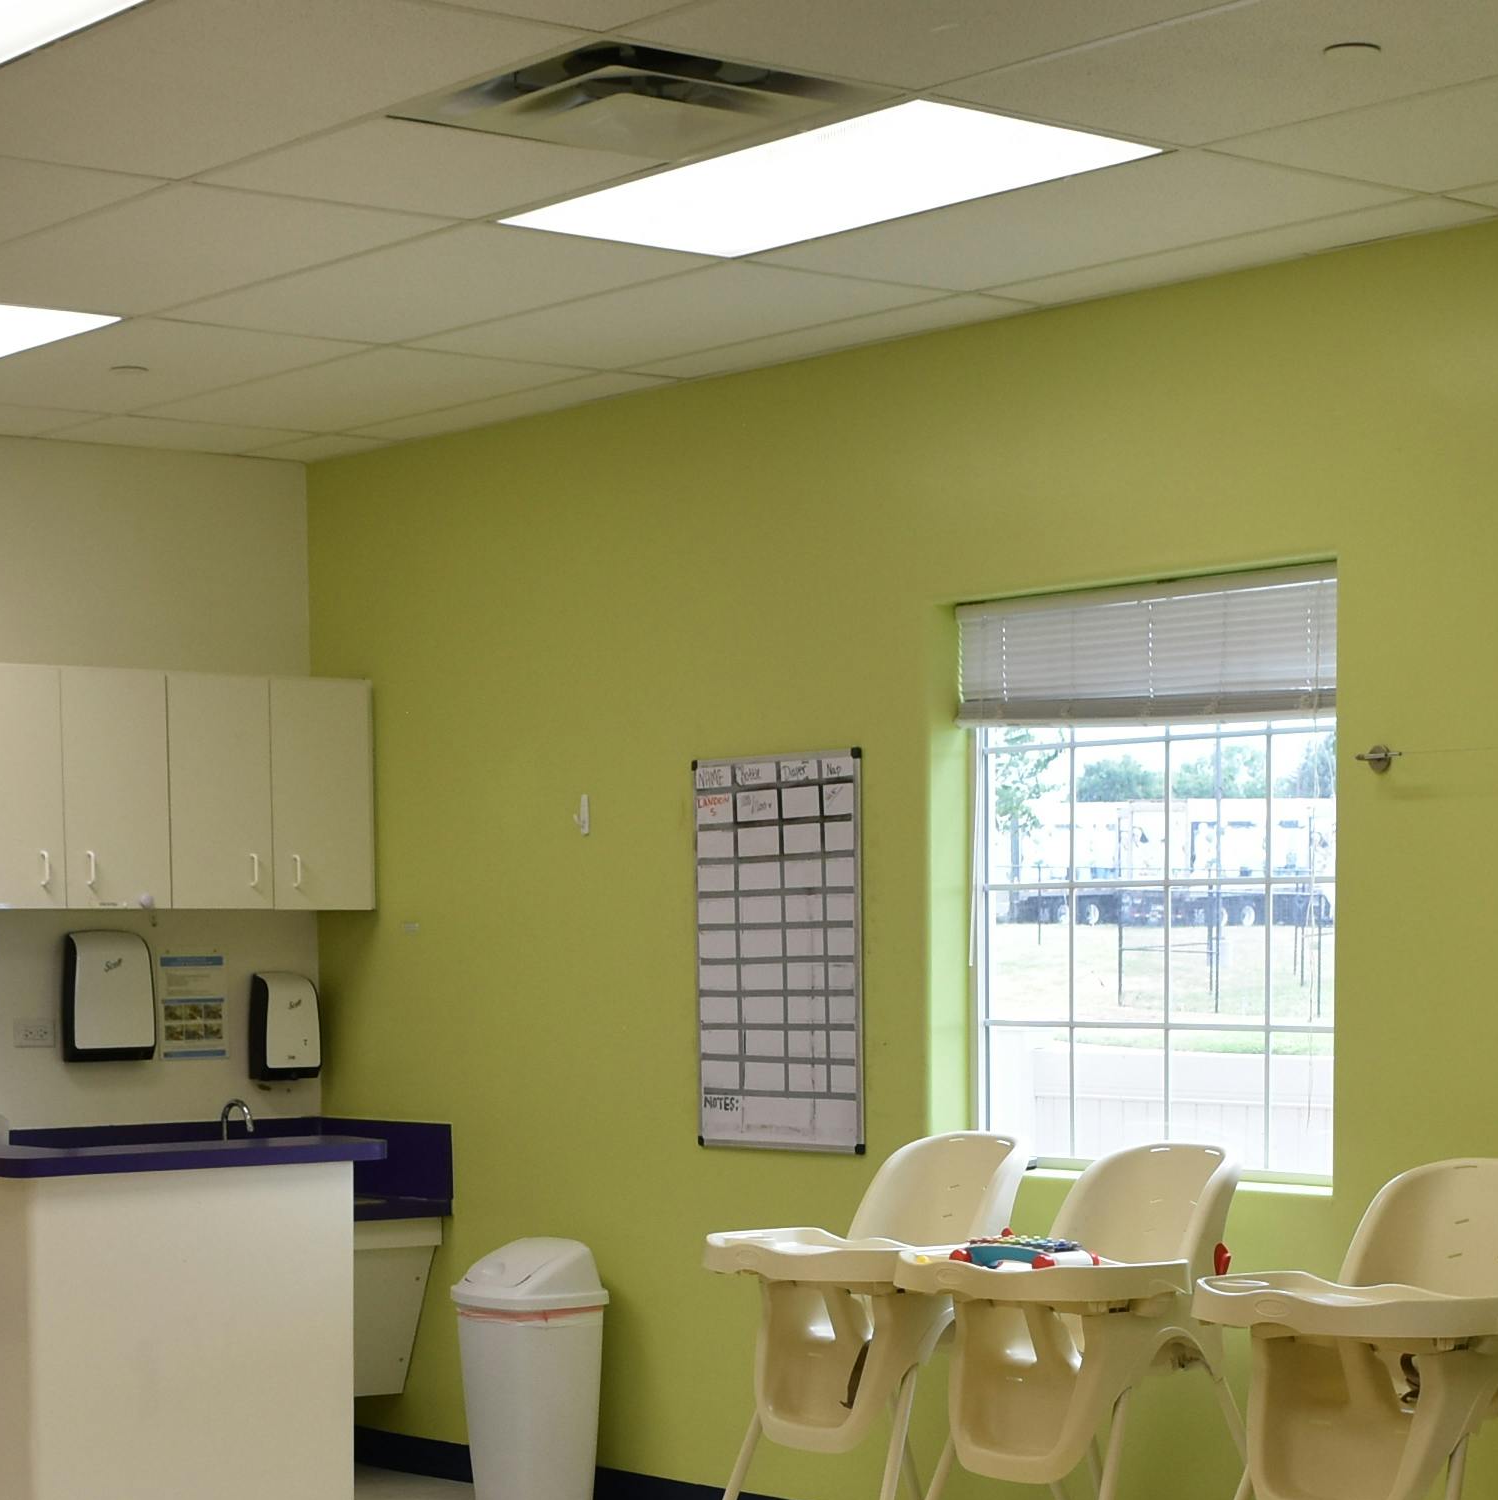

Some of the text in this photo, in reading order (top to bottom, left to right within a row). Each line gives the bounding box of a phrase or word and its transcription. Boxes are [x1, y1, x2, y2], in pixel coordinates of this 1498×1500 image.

[698, 769, 724, 787] NAME
[826, 763, 842, 777] Nap
[703, 1096, 739, 1111] NOTES:
